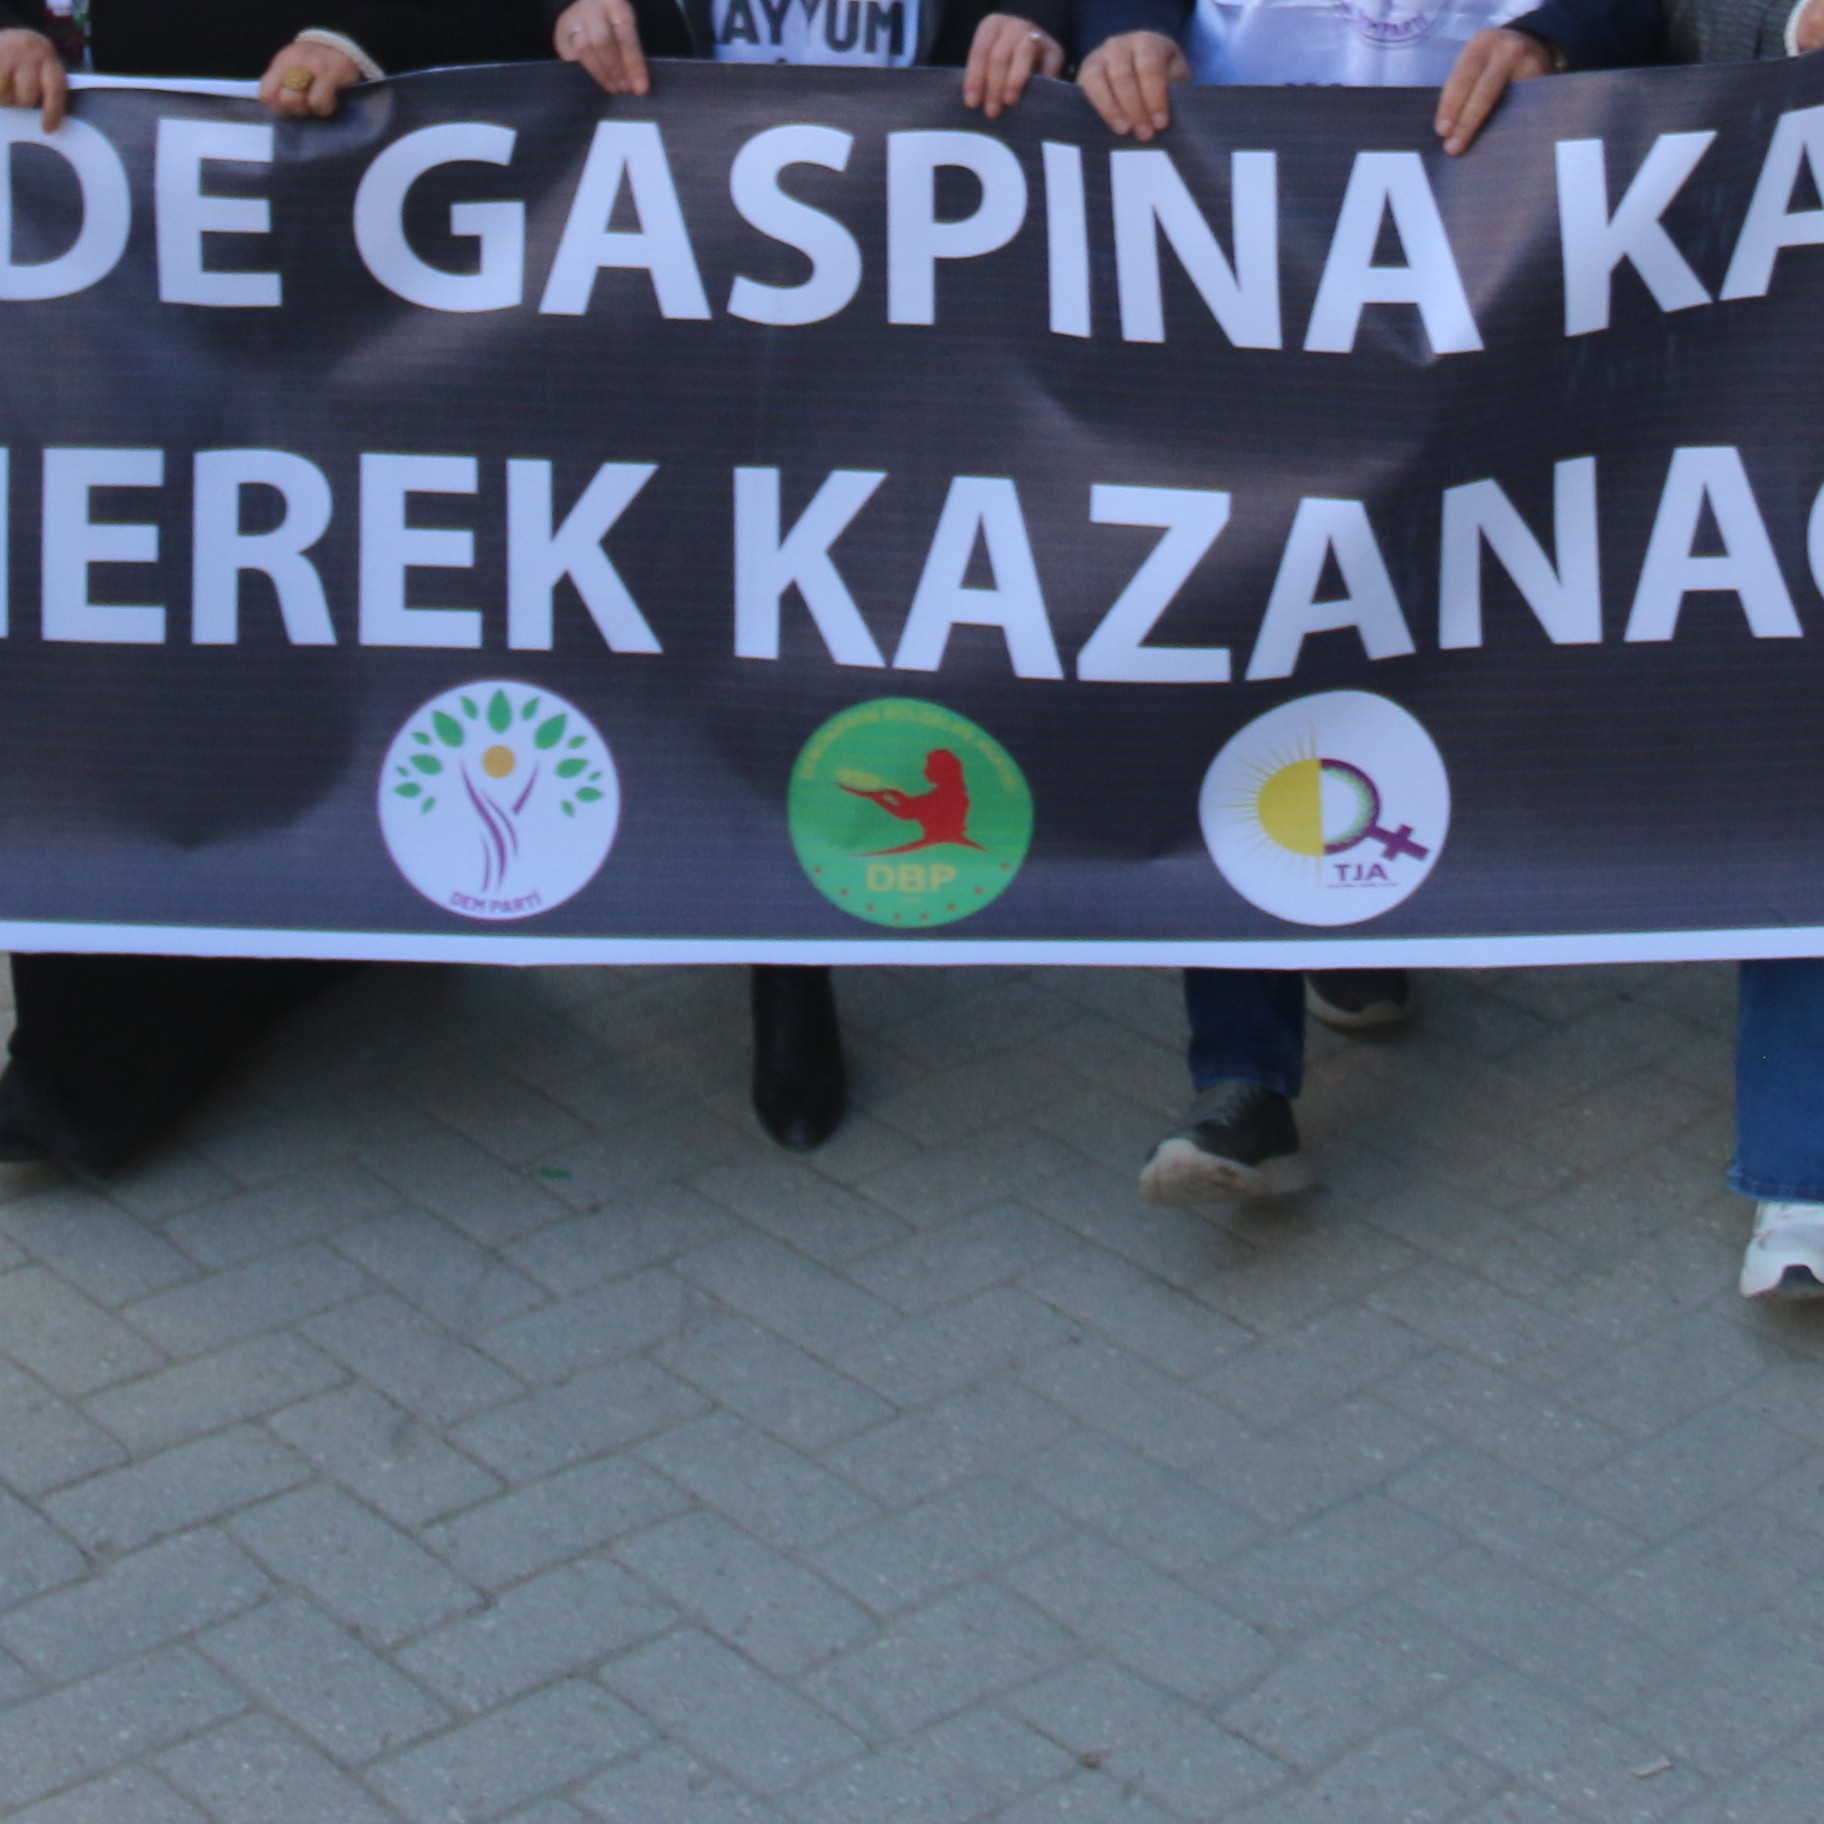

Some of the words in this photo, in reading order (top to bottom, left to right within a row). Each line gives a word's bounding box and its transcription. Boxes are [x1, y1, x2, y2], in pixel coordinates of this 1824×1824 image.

[354, 120, 1484, 355] GASPINA
[865, 862, 958, 893] DBP
[1333, 863, 1389, 882] TJA
[450, 890, 486, 912] DEM
[490, 888, 543, 913] PARTİ
